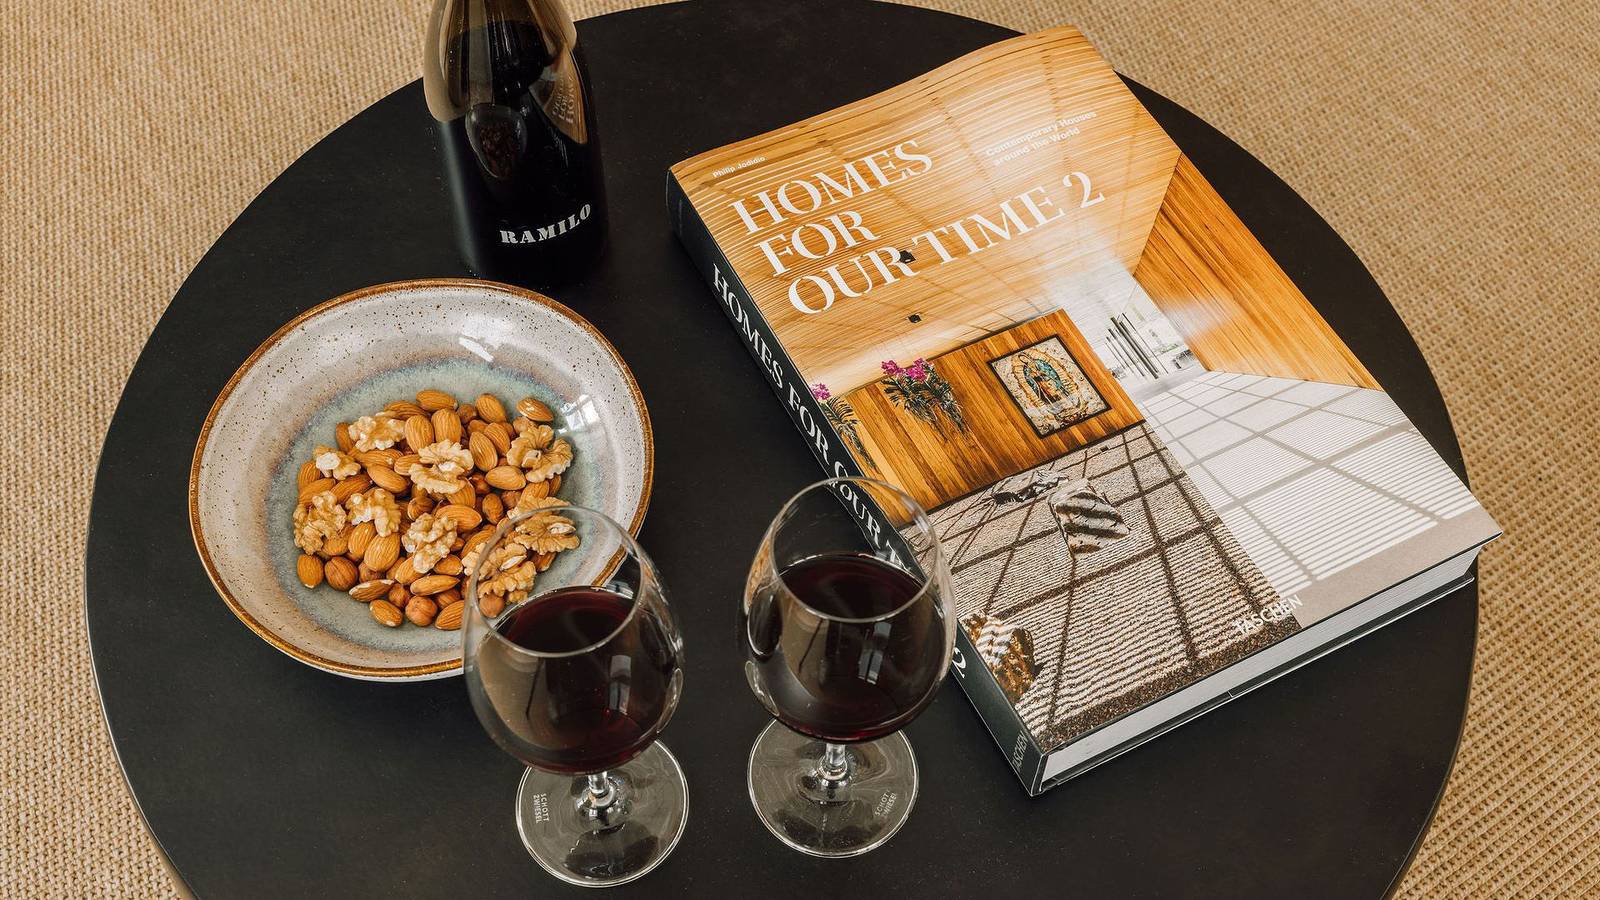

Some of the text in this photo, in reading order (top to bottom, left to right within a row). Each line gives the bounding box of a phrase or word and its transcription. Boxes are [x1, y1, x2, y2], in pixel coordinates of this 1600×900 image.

[985, 111, 1097, 156] Contemporary Houses
[994, 146, 1030, 166] around
[1050, 127, 1081, 143] World
[712, 156, 766, 178] Philip Jodidio
[728, 140, 933, 236] HOMES
[499, 203, 591, 244] RAMILO
[754, 211, 881, 277] FOR
[788, 171, 1106, 314] OUR TIME 2
[713, 263, 783, 389] HOMES
[788, 382, 830, 466] FOR
[1232, 594, 1304, 634] TASCHEN
[541, 793, 550, 822] SCHOTT
